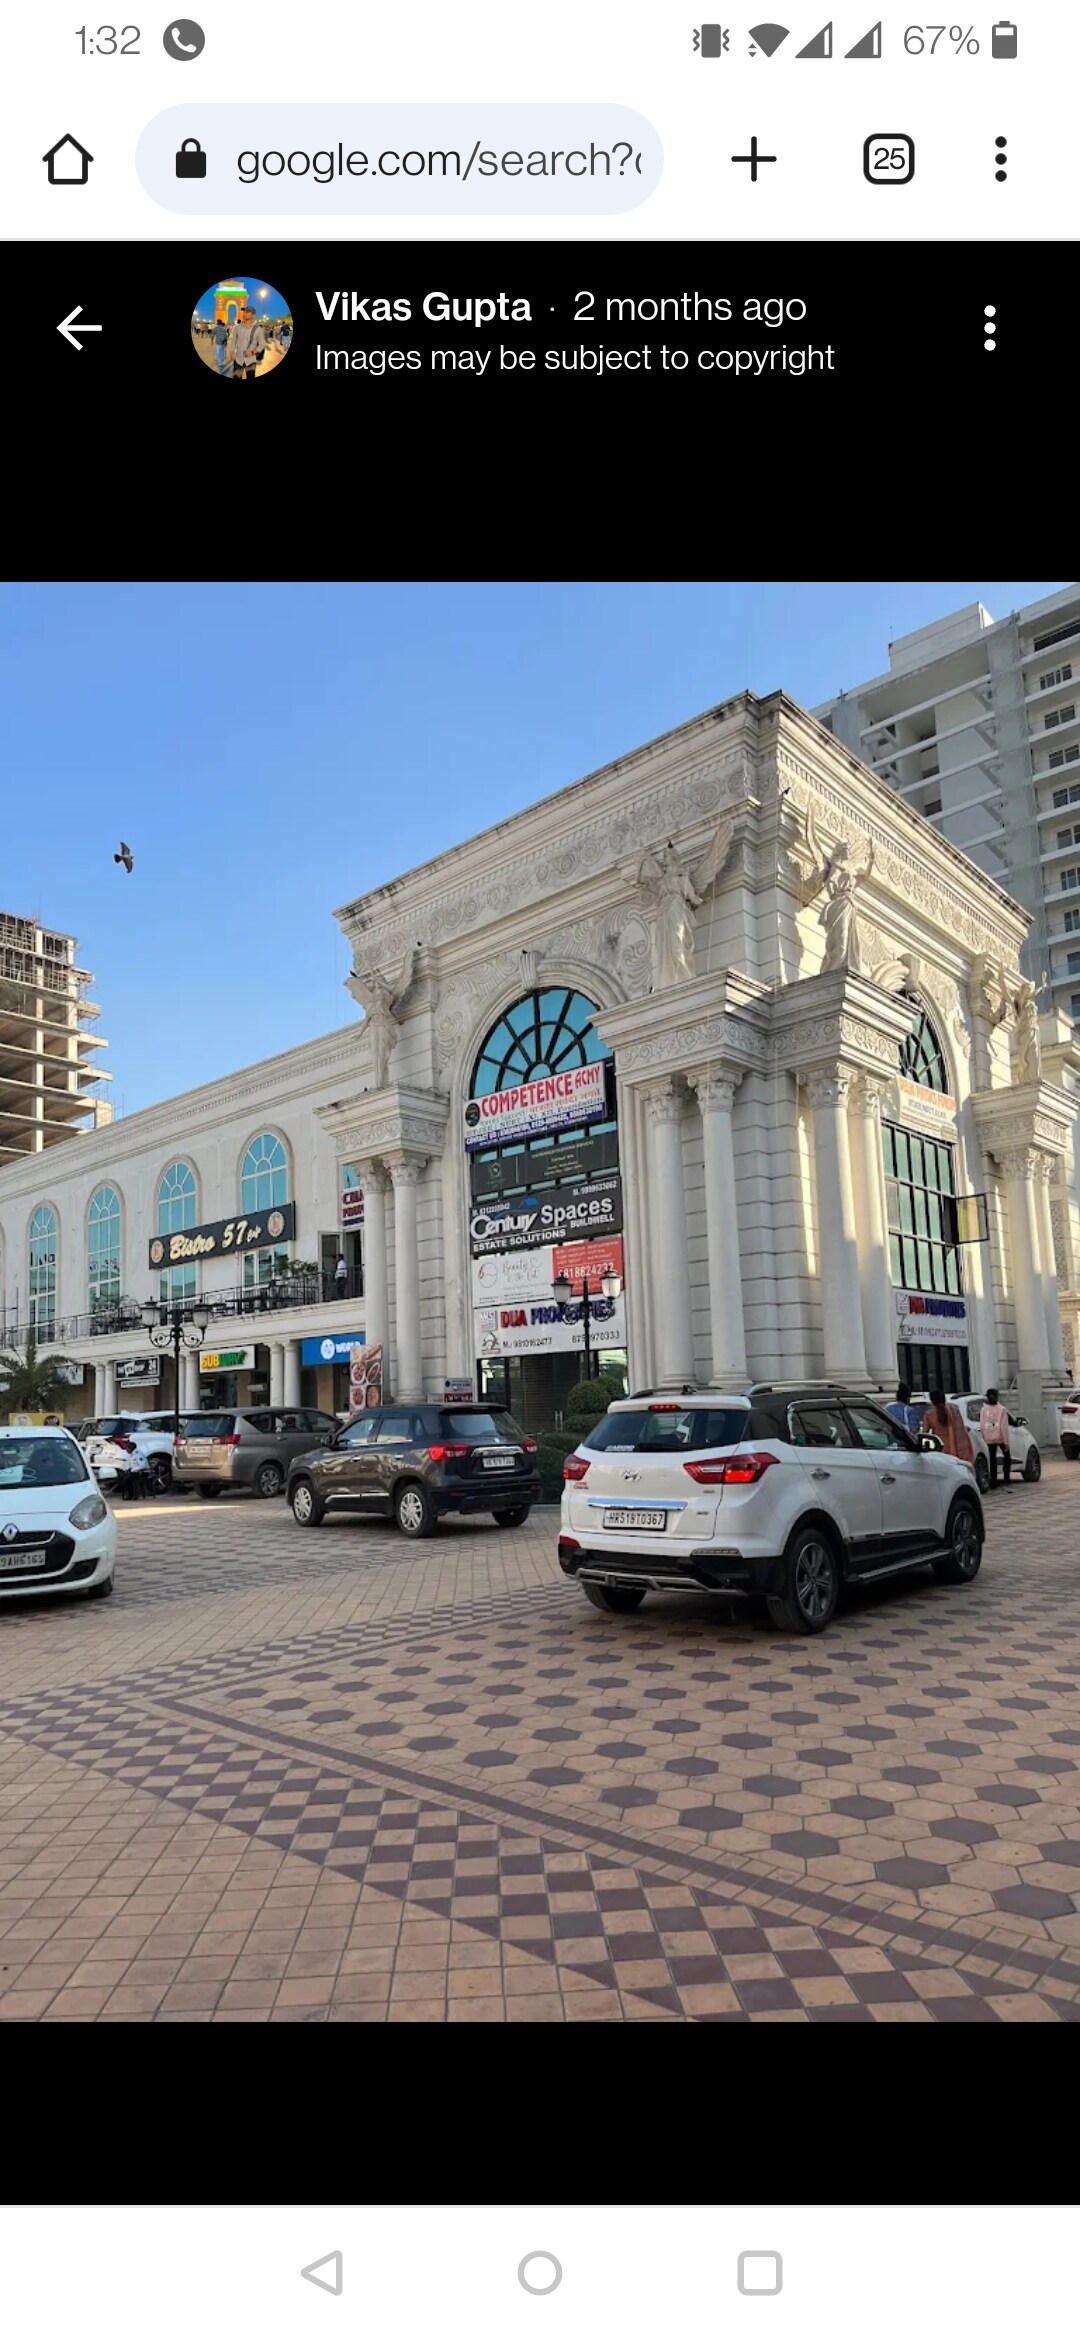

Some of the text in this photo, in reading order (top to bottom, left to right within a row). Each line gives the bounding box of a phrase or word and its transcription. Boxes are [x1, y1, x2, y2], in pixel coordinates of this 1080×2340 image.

[76, 26, 141, 56] 1:32
[904, 26, 980, 56] 67%
[873, 146, 906, 172] 25
[315, 291, 807, 328] Vikas Gupta 2 months ago
[316, 344, 836, 376] Images may be subject to copyright
[481, 1074, 573, 1117] COMPETENCE
[470, 1212, 538, 1240] Century
[541, 1198, 613, 1226] Spaces
[570, 1213, 615, 1228] BUILDWELL
[169, 1234, 216, 1260] Bistro
[221, 1220, 248, 1248] 57
[473, 1229, 566, 1252] ESTATE SOLUTIONS
[500, 1310, 528, 1328] DUA
[572, 1331, 620, 1344] 875970333
[202, 1350, 247, 1370] SUBWAY
